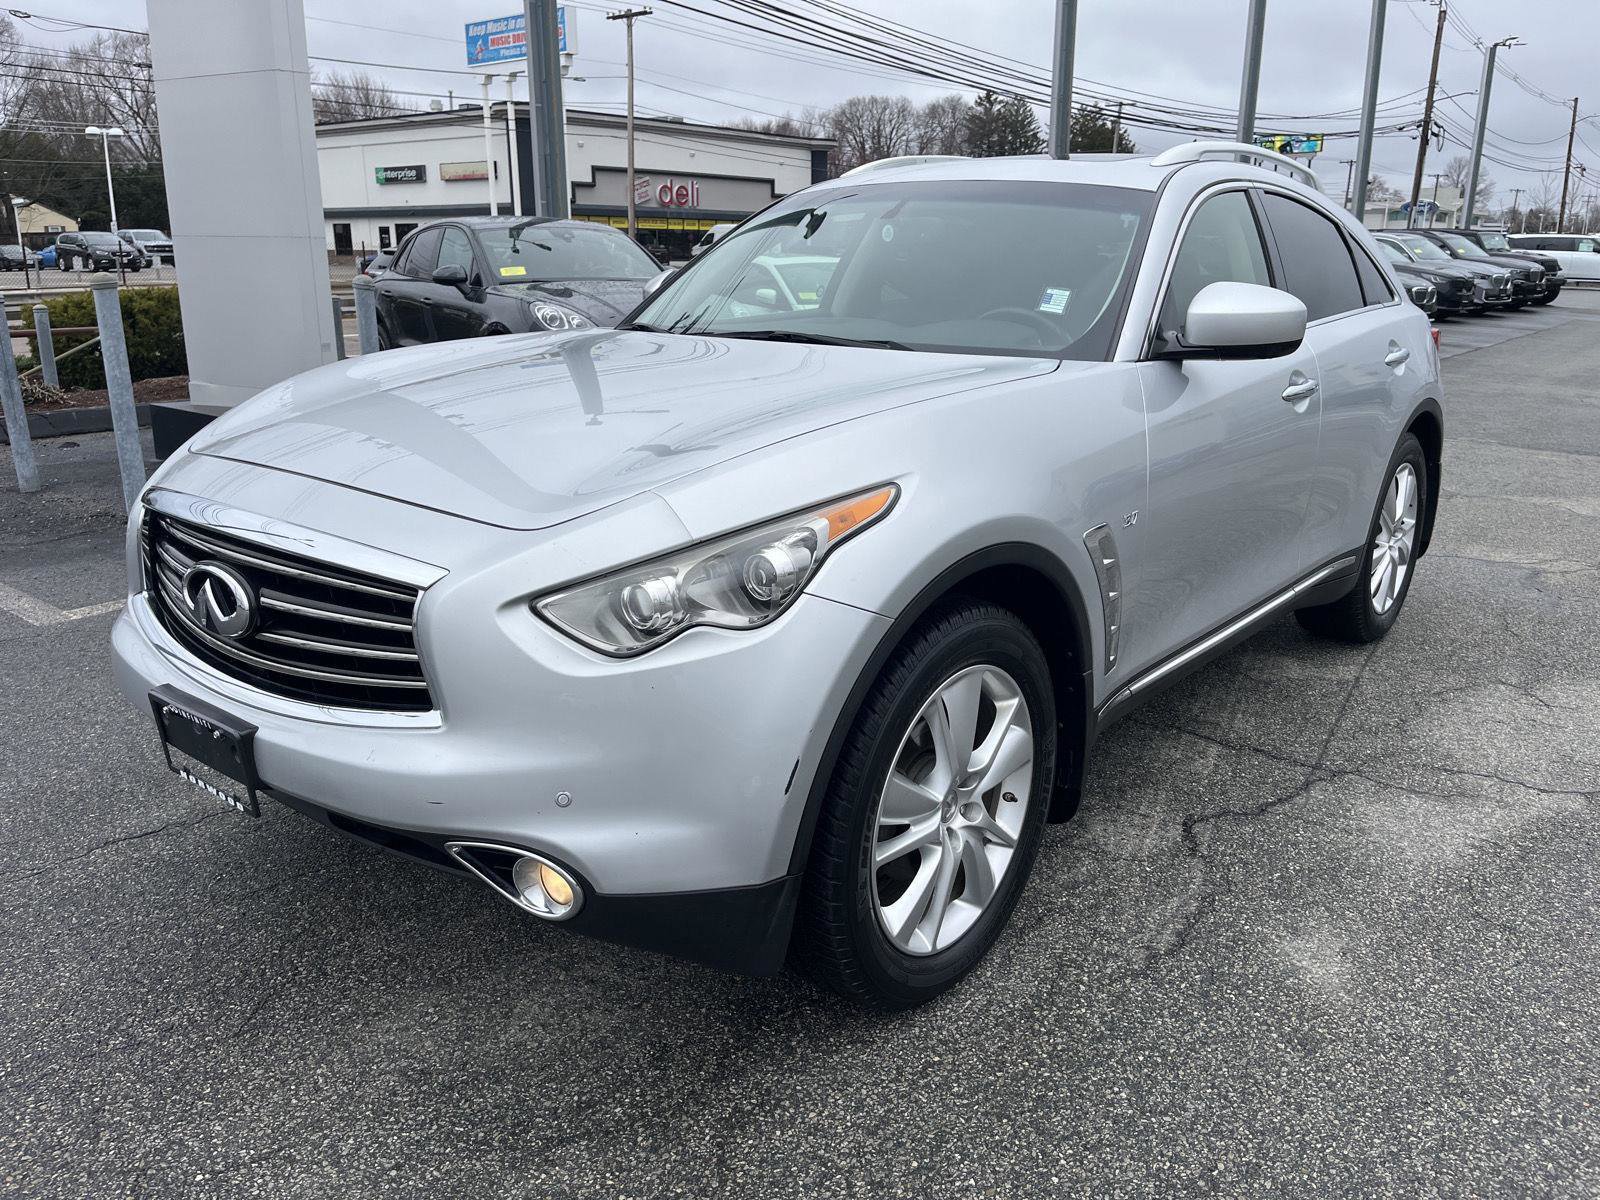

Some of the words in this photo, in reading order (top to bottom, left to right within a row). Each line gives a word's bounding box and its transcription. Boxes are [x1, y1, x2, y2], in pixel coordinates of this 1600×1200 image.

[490, 35, 511, 47] MUSIC
[378, 168, 417, 179] enterprise
[655, 179, 700, 207] deli
